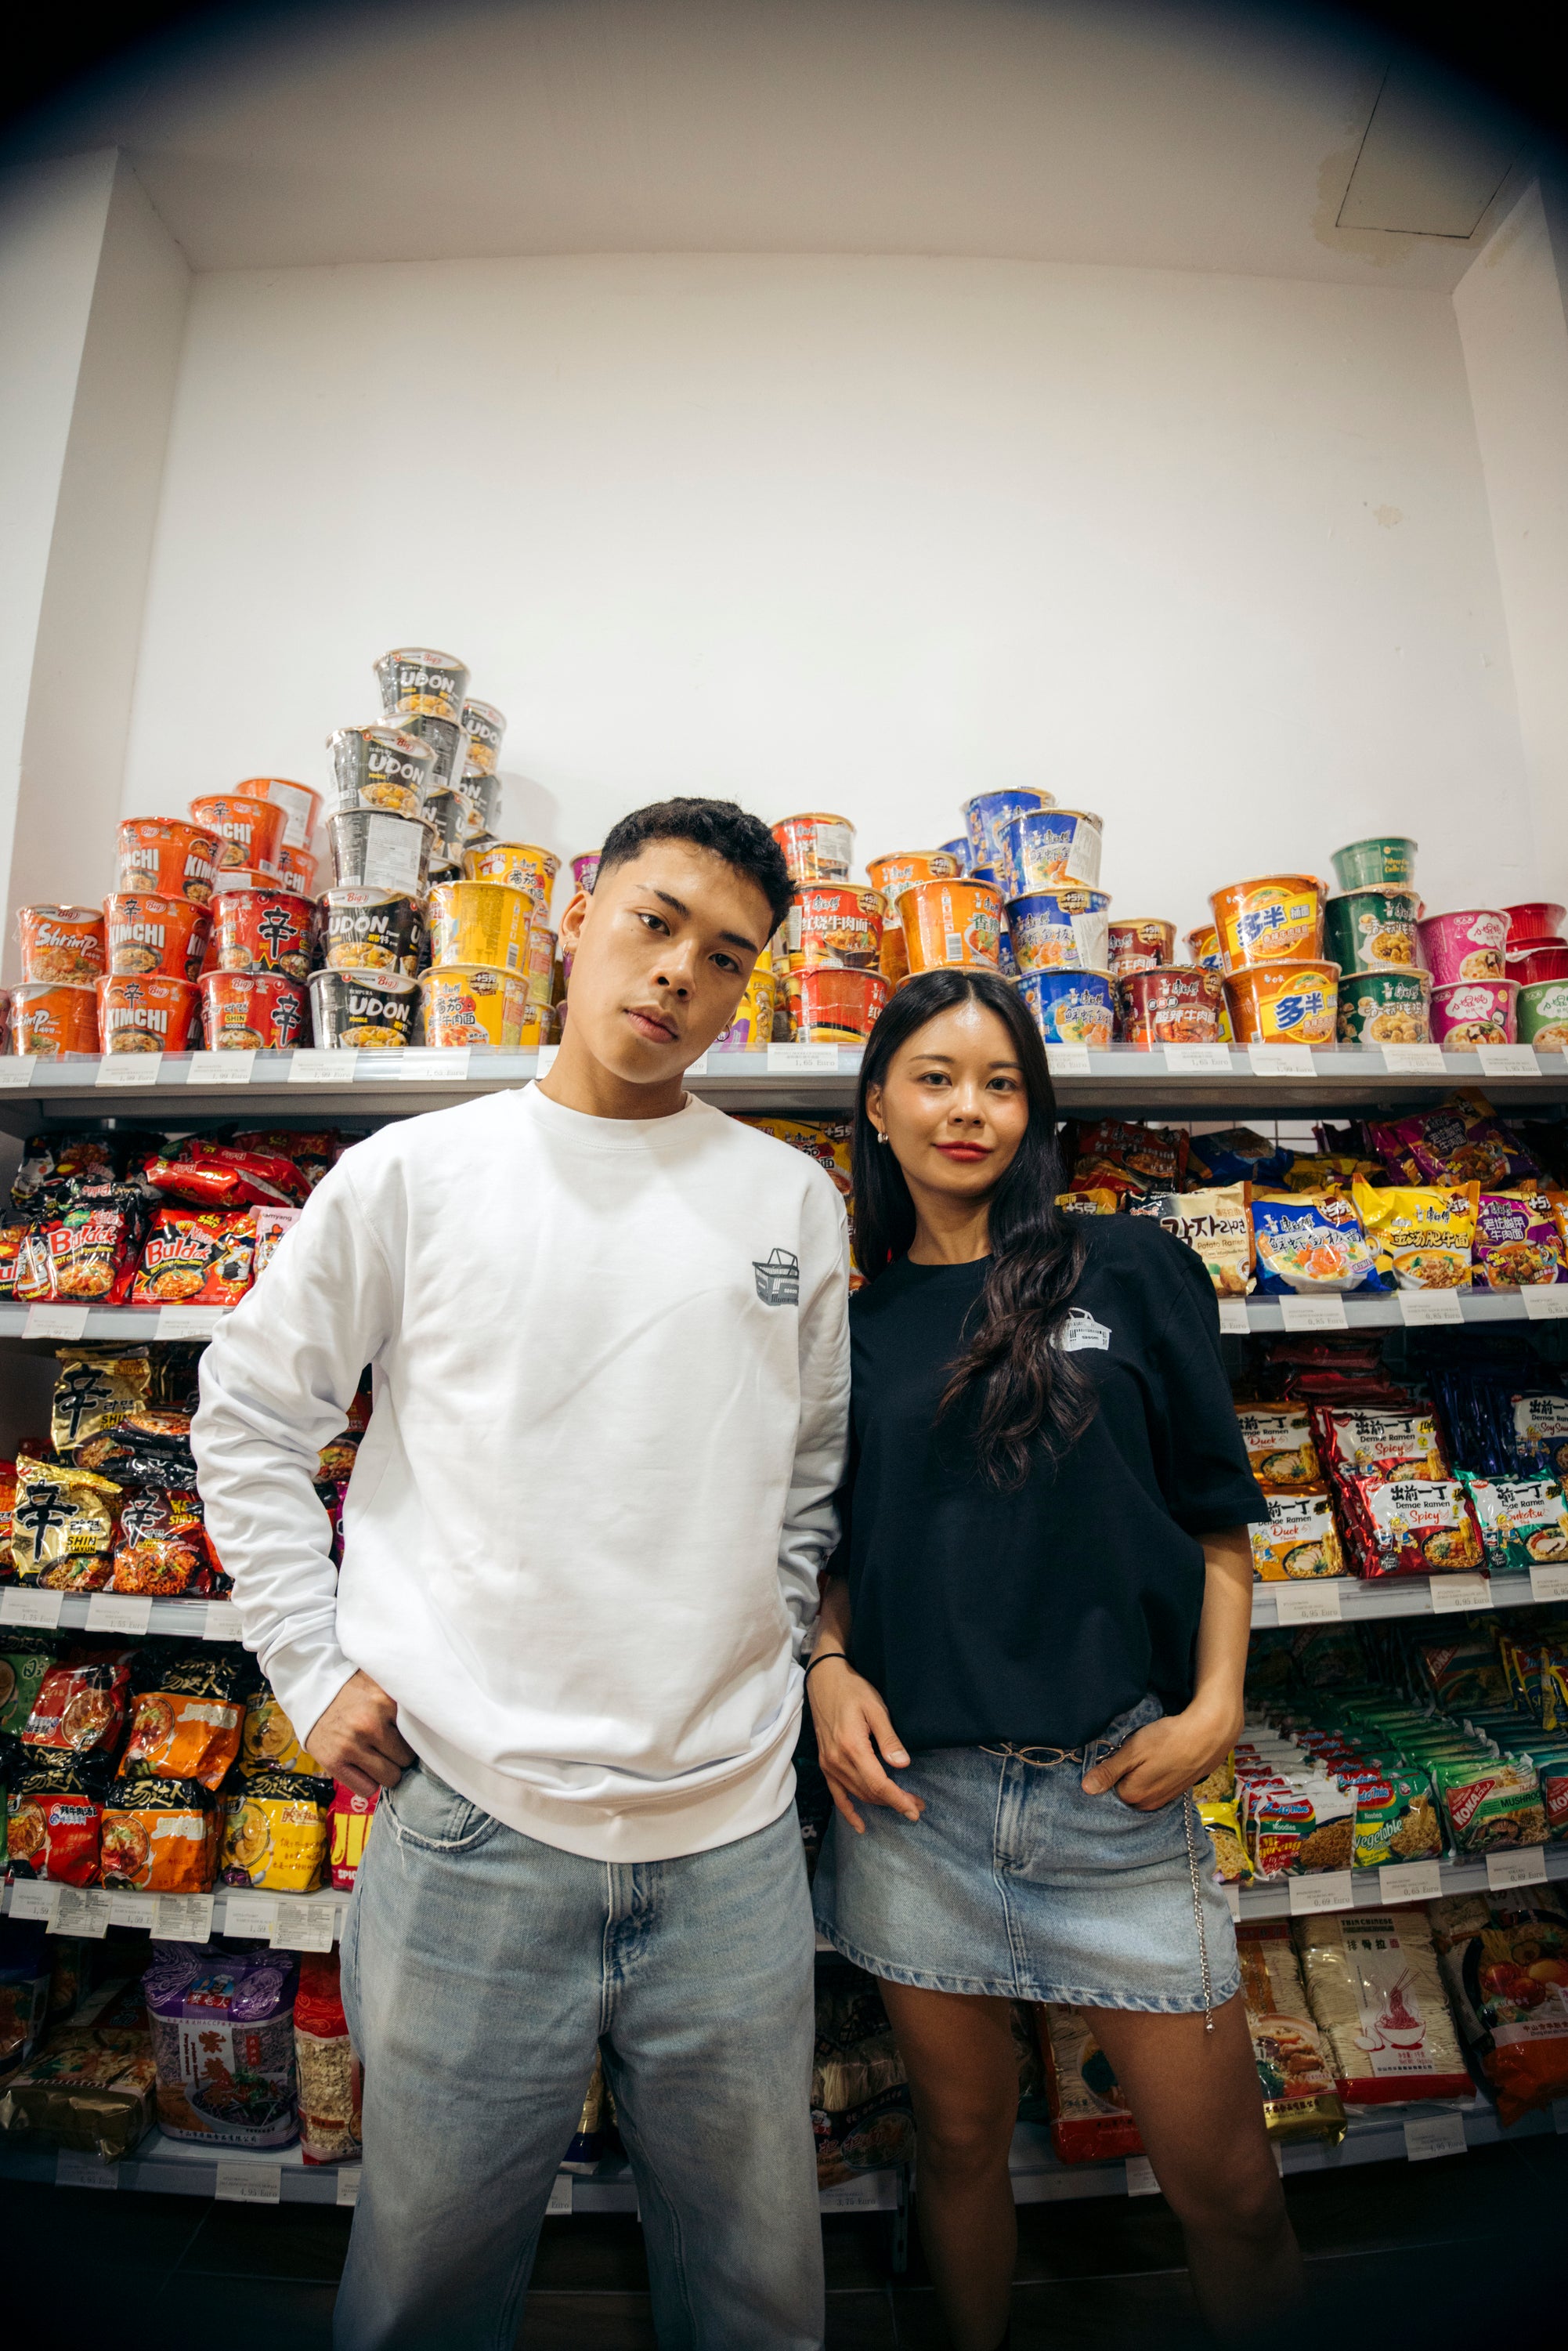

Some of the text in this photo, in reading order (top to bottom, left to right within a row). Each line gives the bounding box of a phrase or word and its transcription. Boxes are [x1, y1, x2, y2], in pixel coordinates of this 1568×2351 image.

[400, 671, 455, 693] UDON
[466, 719, 500, 744] UDO
[396, 736, 414, 752] Big
[368, 753, 424, 784] UDON
[146, 900, 163, 911] Big
[347, 892, 368, 904] Big
[57, 909, 76, 920] Big
[124, 899, 142, 924] 辛
[328, 916, 389, 935] UDON
[801, 915, 869, 933] 红烧牛肉面
[1237, 905, 1287, 948] 多半
[258, 906, 298, 960] 辛
[233, 978, 252, 990] Big
[378, 975, 398, 988] Big
[124, 982, 144, 1010] 辛
[149, 985, 166, 996] Big
[349, 996, 410, 1022] UDON
[1155, 1010, 1217, 1024] 酸辣牛肉面
[1274, 991, 1324, 1030] 多半
[107, 1007, 168, 1034] KIMCHI
[271, 993, 302, 1046] 辛
[1483, 1216, 1526, 1231] 老坛酸菜
[49, 1226, 117, 1257] Buldak
[1391, 1229, 1470, 1249] 金汤肥牛面
[1490, 1228, 1524, 1241] 牛肉面
[1197, 1239, 1245, 1250] Potato Ramen
[146, 1238, 212, 1268] Buldak
[54, 1363, 114, 1441] 辛
[103, 1399, 135, 1413] 라면
[1356, 1418, 1414, 1436] 出前一丁
[1541, 1422, 1555, 1435] Soy
[1248, 1434, 1277, 1447] Duck
[1360, 1433, 1415, 1443] Demae Ramen
[1375, 1442, 1404, 1456] Spicy
[1390, 1485, 1448, 1502] 出前一丁
[1267, 1499, 1310, 1519] 前一丁
[1396, 1500, 1451, 1510] Demae Ramen
[1520, 1499, 1545, 1508] Ramen
[16, 1478, 80, 1564] 辛
[121, 1488, 168, 1550] 辛
[1286, 1515, 1312, 1524] Ramen
[1409, 1509, 1440, 1525] Spicy
[1270, 1524, 1299, 1537] Duck
[67, 1536, 97, 1546] SHIN
[1454, 1596, 1490, 1606] 0,95 Euro
[1301, 1608, 1339, 1619] 0,95 Euro
[123, 1779, 192, 1808] 汤达人
[1501, 1792, 1542, 1808] MUSHROO
[1453, 1792, 1480, 1826] KOKA
[1273, 1823, 1296, 1832] Noodles
[1356, 1818, 1404, 1850] Vegetable
[1510, 1874, 1526, 1883] 0,89
[1403, 1885, 1439, 1896] 0,65 Euro
[1314, 1896, 1349, 1907] 0,69 Euro
[34, 1907, 49, 1915] 1,59
